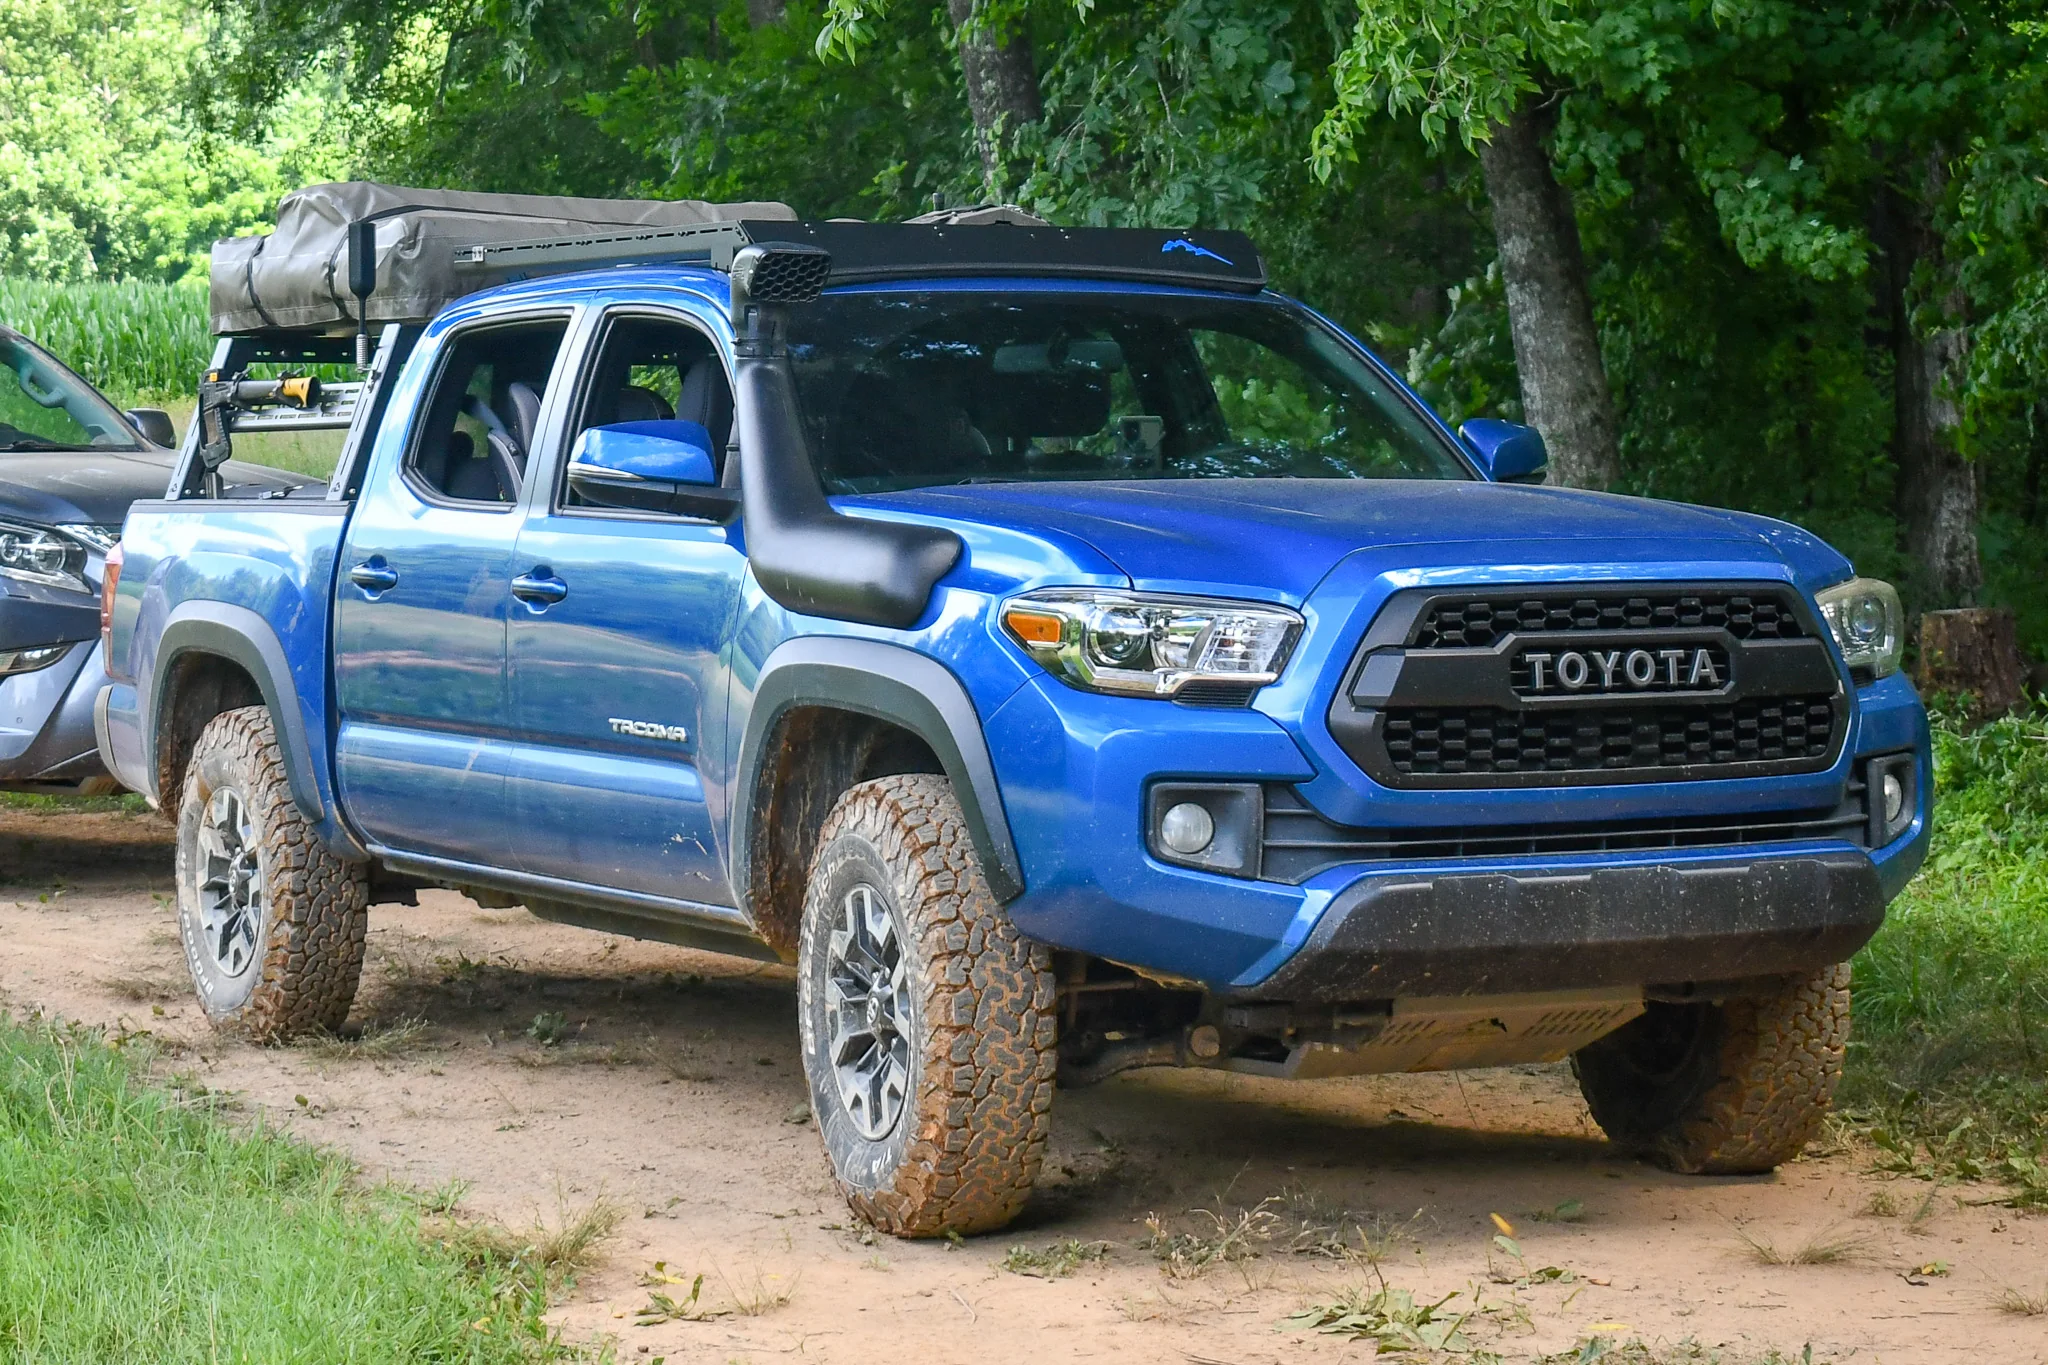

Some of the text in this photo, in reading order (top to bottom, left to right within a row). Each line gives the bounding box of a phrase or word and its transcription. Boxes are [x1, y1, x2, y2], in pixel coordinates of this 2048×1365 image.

[1524, 649, 1720, 690] TOYOTA
[608, 718, 687, 742] TACOMA
[180, 851, 214, 995] BFGoodh
[803, 861, 836, 1056] BFGoodrich
